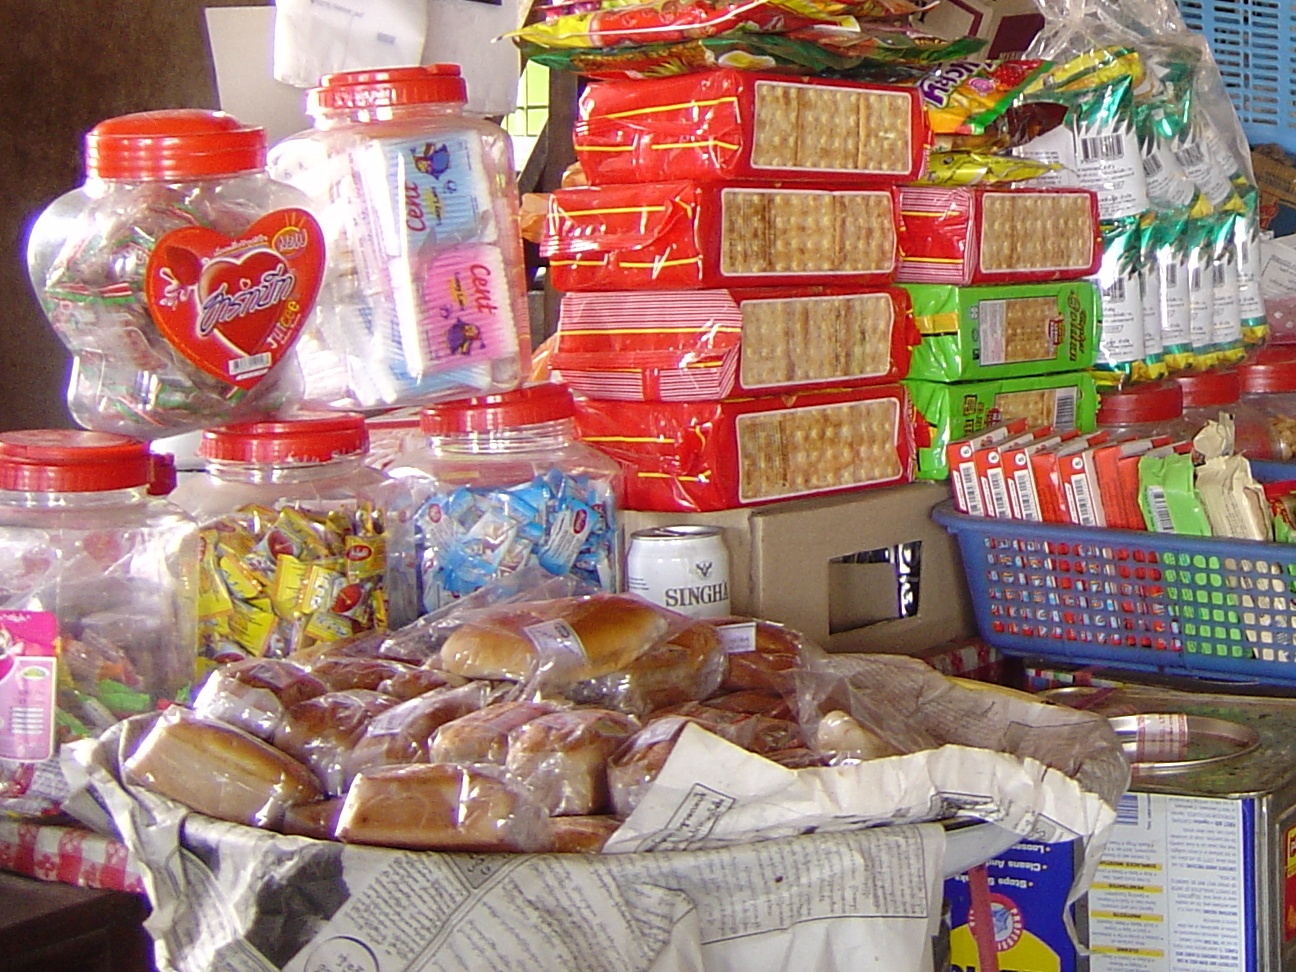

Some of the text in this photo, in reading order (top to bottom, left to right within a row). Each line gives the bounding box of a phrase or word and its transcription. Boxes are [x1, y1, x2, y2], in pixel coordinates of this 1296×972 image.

[469, 263, 499, 315] Cent
[665, 582, 729, 608] SINGHA
[1007, 860, 1042, 872] Cleans
[998, 876, 1029, 889] Stops
